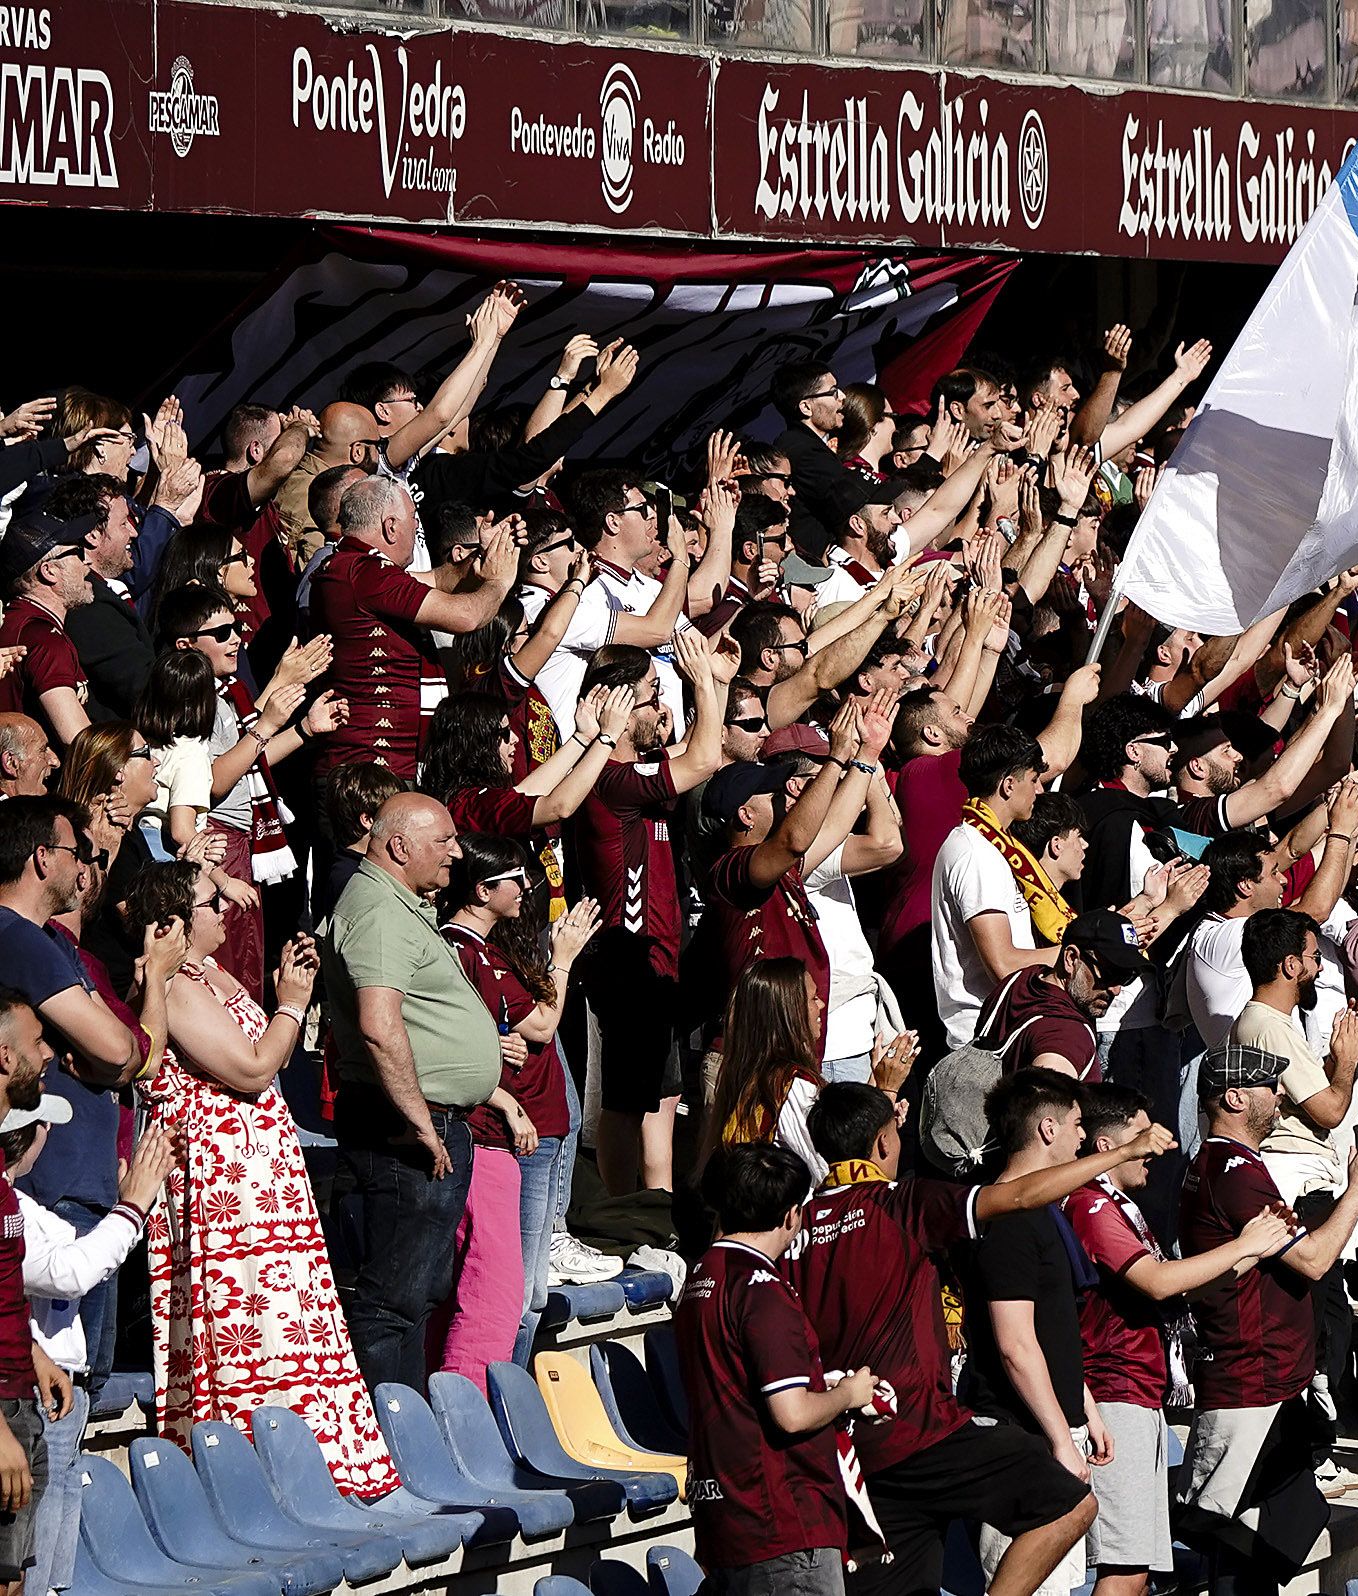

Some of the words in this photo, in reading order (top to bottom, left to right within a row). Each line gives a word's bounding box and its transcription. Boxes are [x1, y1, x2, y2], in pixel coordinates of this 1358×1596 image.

[149, 91, 220, 136] PESCAMAR
[511, 106, 596, 159] Pontevedra
[643, 117, 685, 165] Radio
[755, 82, 890, 220] Estrella
[897, 90, 1011, 228] Galicia
[1119, 112, 1232, 242] Estrella
[812, 1208, 865, 1237] Deputción
[812, 1218, 866, 1246] Pontedra
